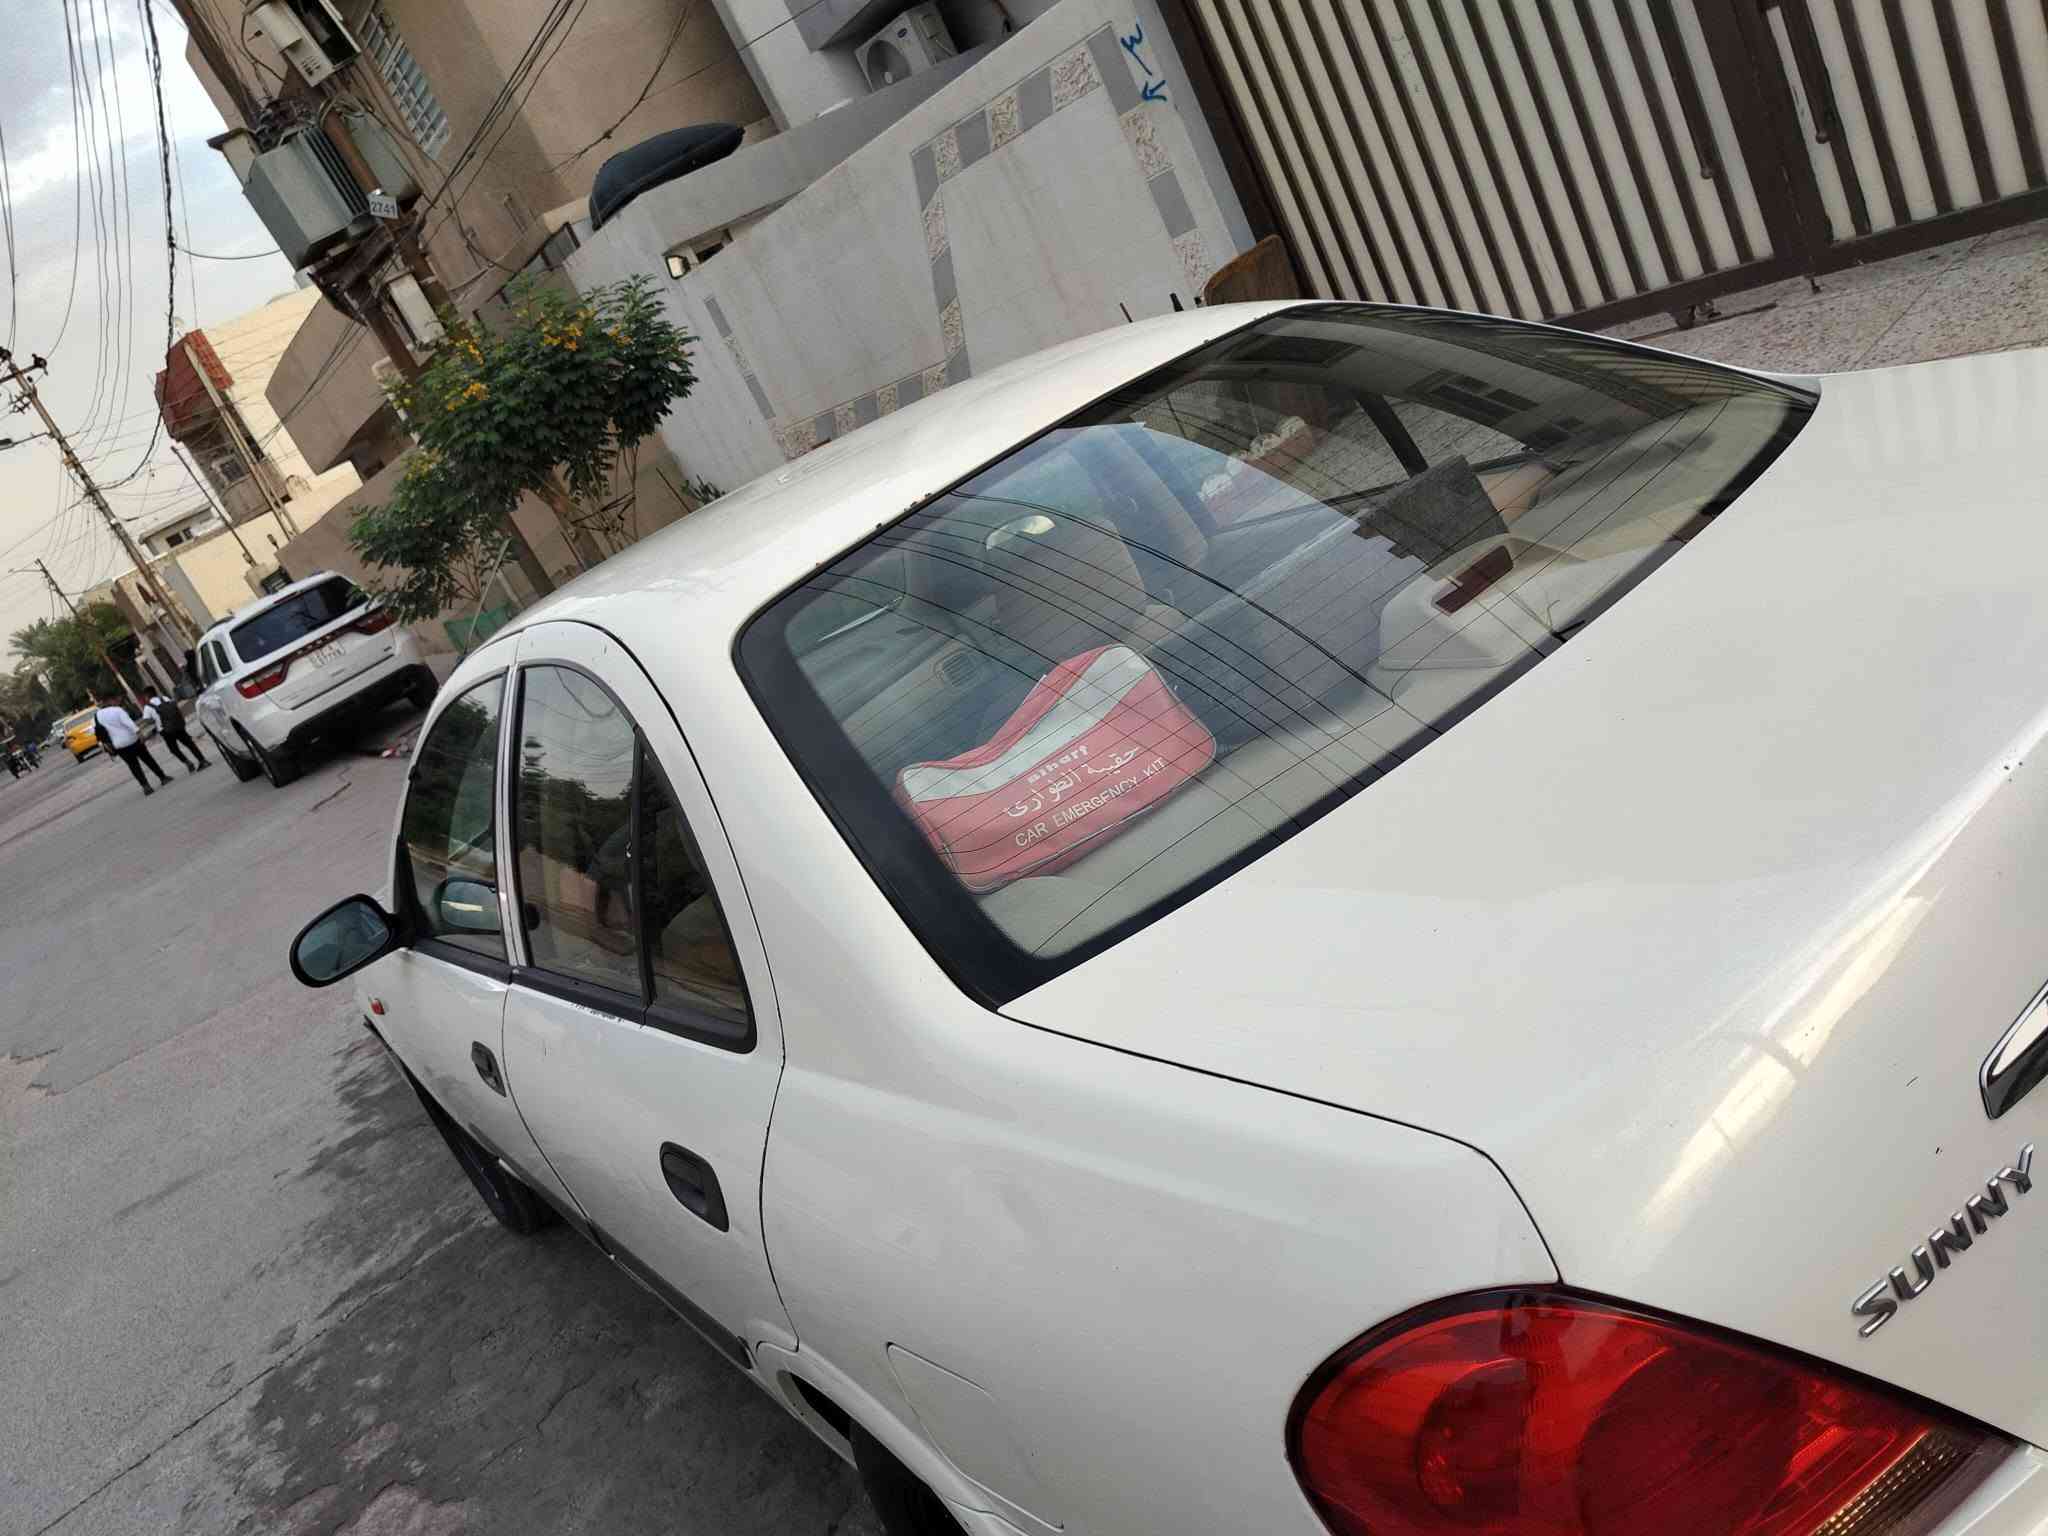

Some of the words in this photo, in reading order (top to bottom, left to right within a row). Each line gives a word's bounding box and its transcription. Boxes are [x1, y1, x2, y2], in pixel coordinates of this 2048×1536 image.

[370, 201, 396, 215] 2741
[1015, 822, 1049, 847] CAR
[1053, 775, 1138, 828] EMERGENCY
[1142, 757, 1167, 780] KIT
[1852, 1142, 2034, 1338] SUNNY
